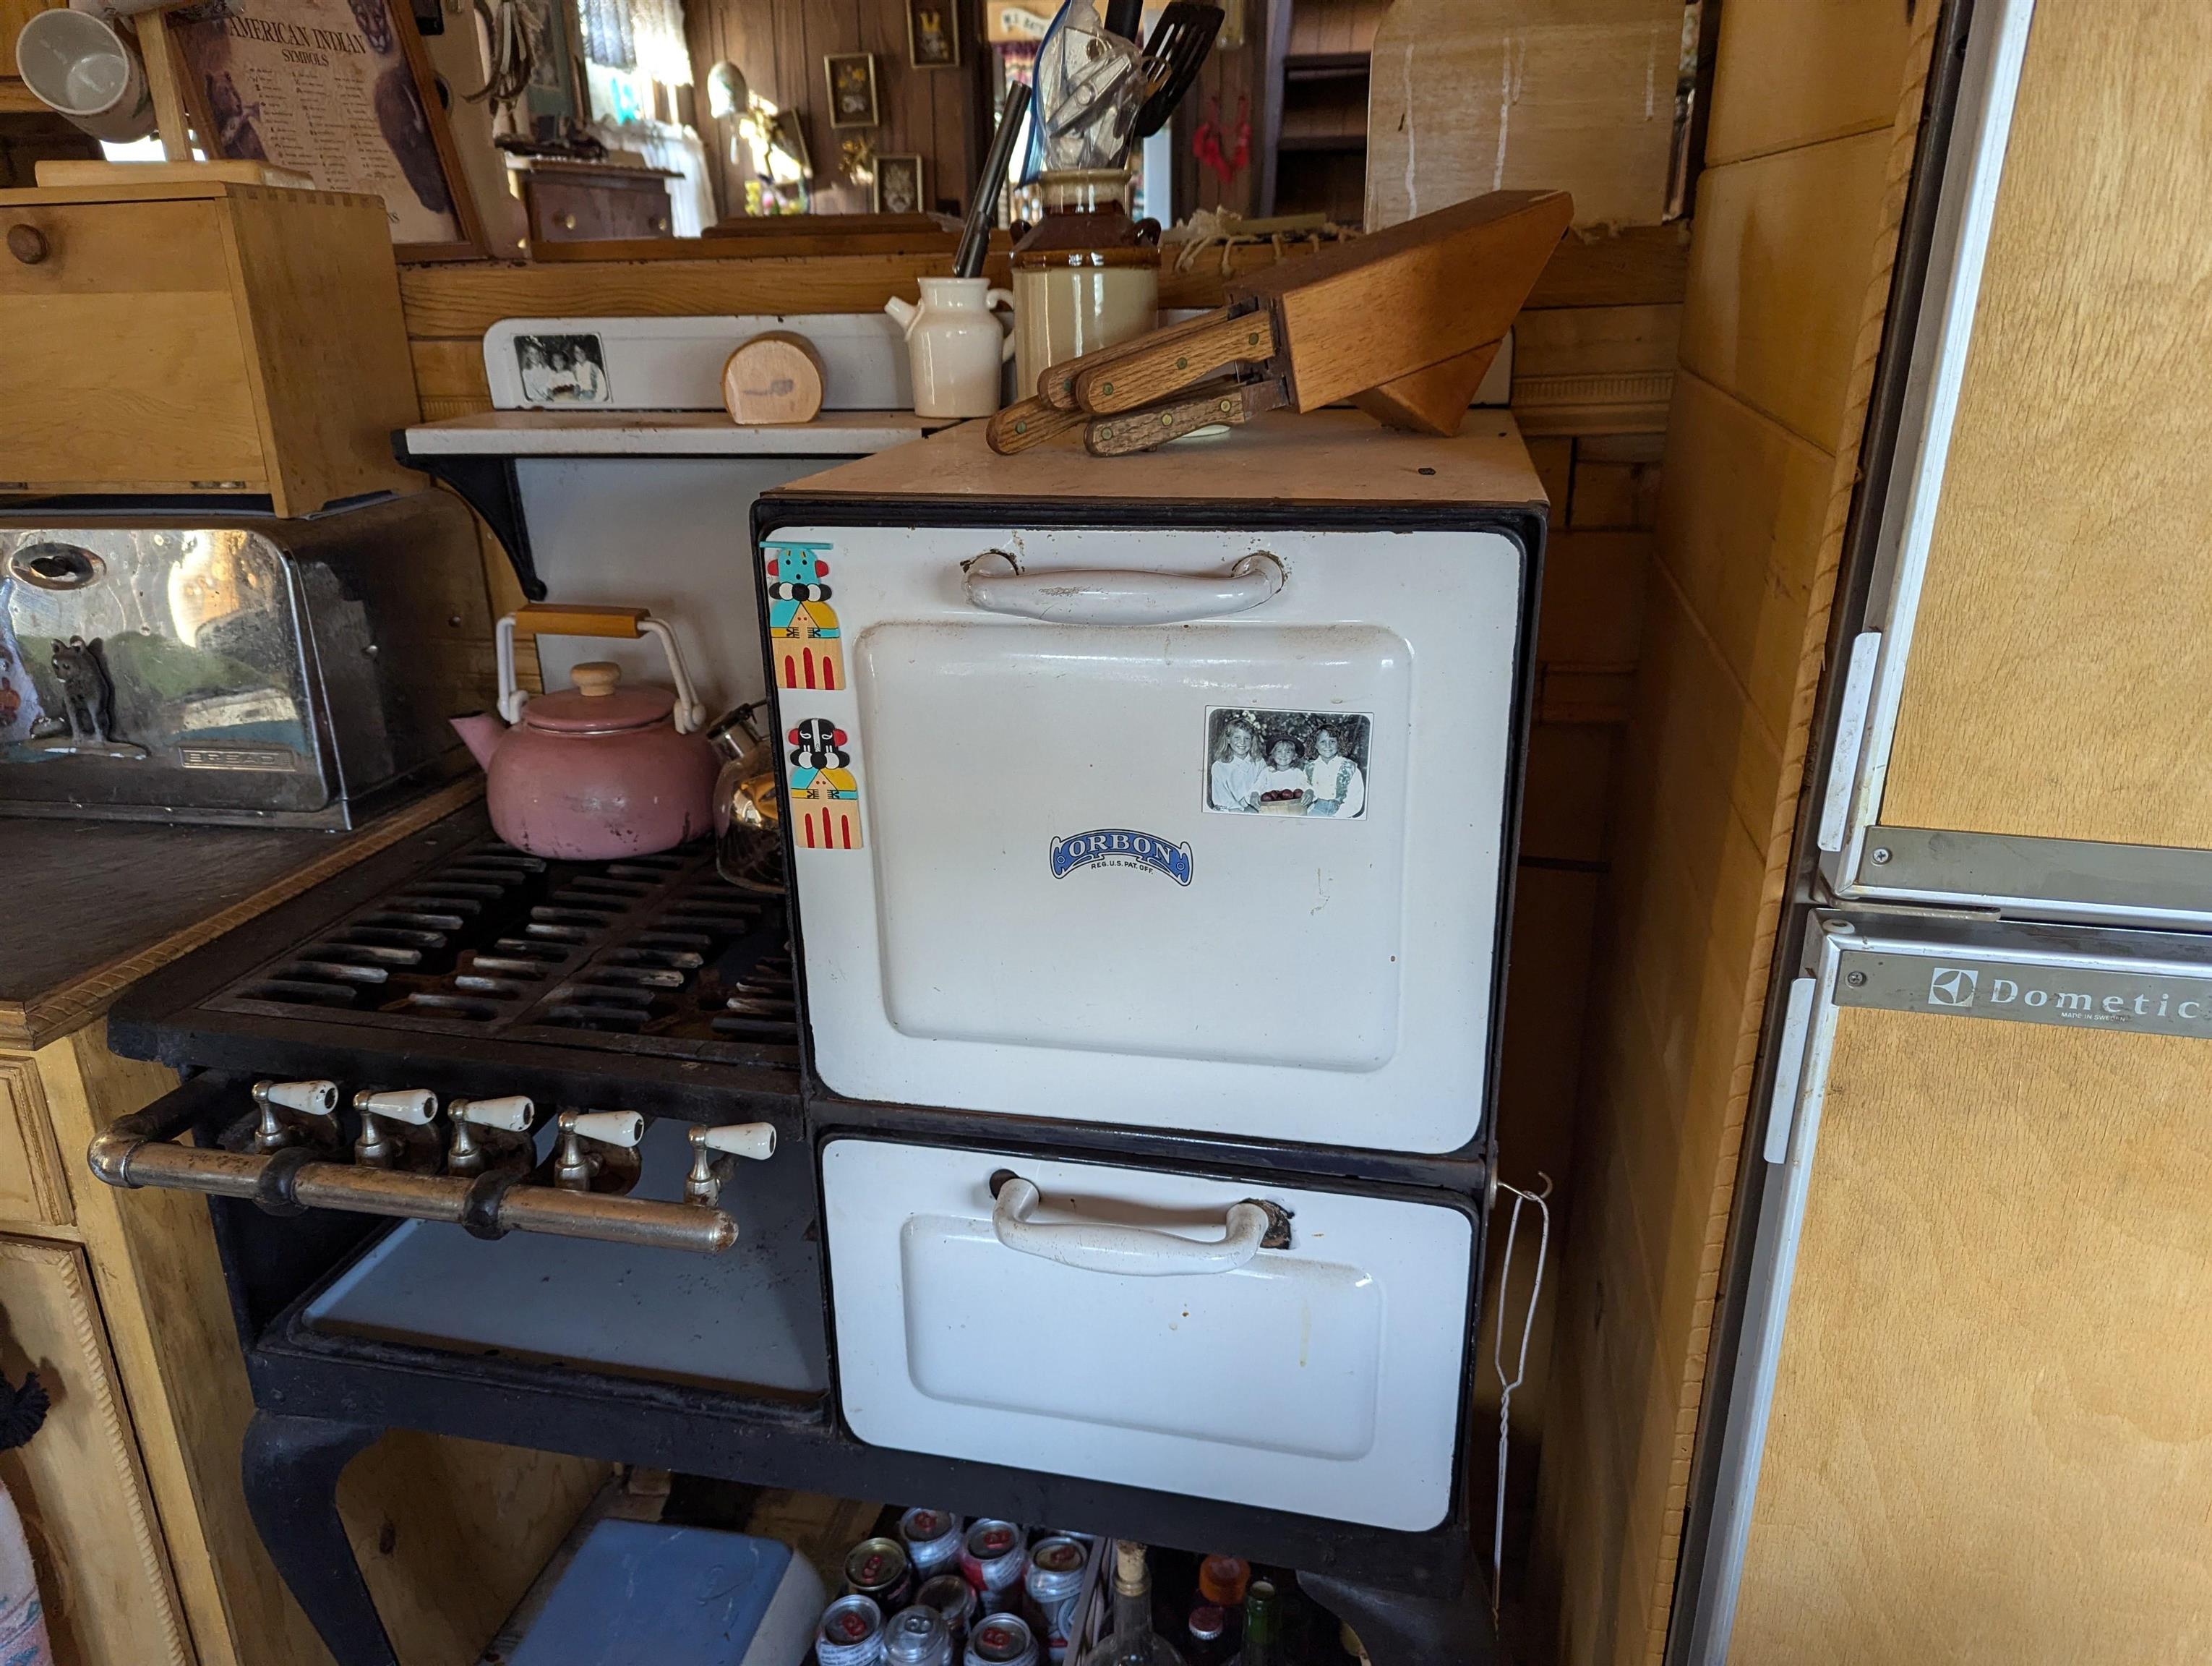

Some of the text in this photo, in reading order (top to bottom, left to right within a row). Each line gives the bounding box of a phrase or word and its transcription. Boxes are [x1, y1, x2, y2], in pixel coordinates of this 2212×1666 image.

[229, 16, 366, 54] AMERICAN INDIAN
[281, 48, 330, 67] SYMBOLS
[189, 753, 275, 765] BREAD
[1068, 833, 1174, 864] ORBON
[1139, 864, 1154, 875] OFF.
[1990, 978, 2200, 1019] Dometic
[2093, 1014, 2126, 1022] SWEDEN
